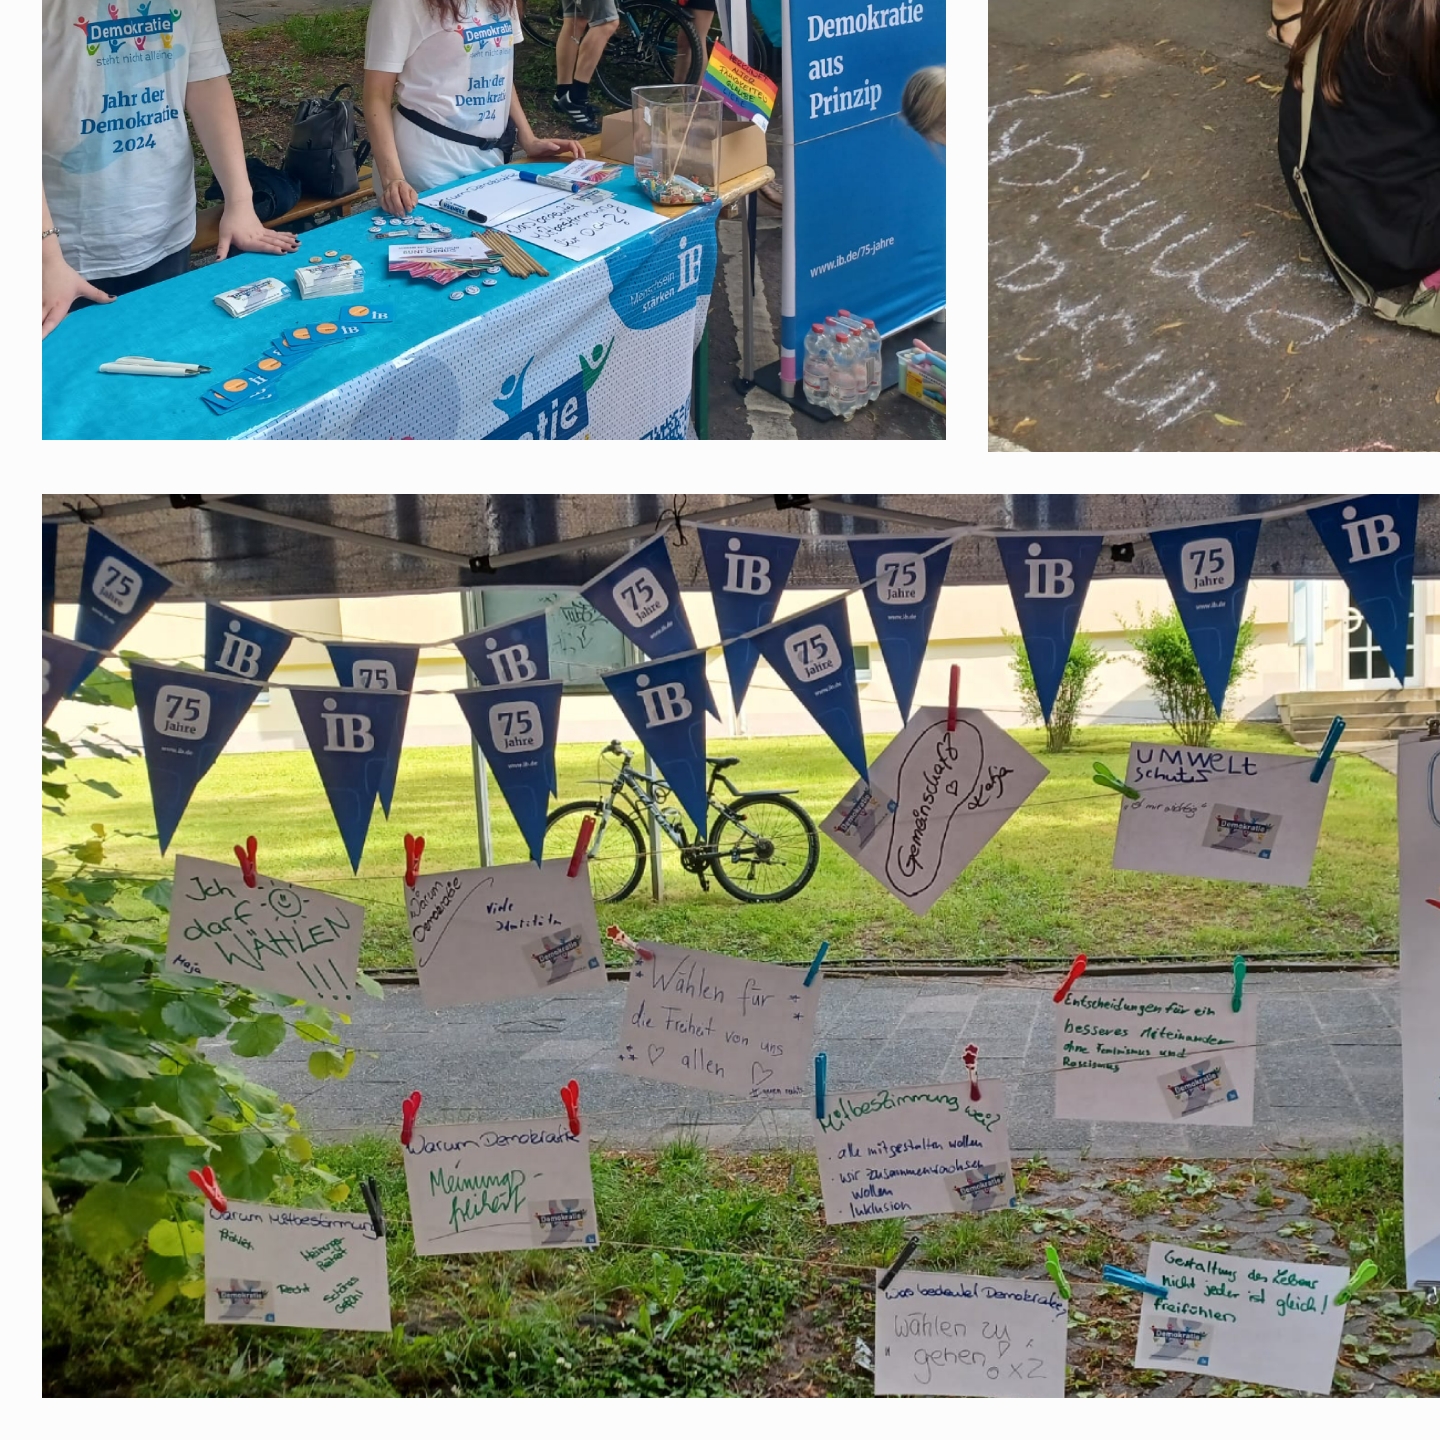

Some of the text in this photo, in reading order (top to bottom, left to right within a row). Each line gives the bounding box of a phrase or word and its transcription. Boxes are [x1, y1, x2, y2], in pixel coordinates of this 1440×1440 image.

[90, 18, 172, 42] Demokratie
[465, 23, 513, 43] Demokratie
[96, 50, 174, 68] steht nicht alleine
[807, 55, 845, 81] aus
[100, 86, 166, 114] Jahr der
[808, 79, 883, 121] Prinzip
[80, 104, 180, 136] Demokratie
[112, 133, 157, 155] 2024
[809, 234, 896, 279] www.ib.de/75-jahre
[630, 271, 676, 308] Menschsein
[642, 287, 675, 314] stärken
[1189, 546, 1226, 575] 75
[103, 566, 132, 596] 75
[883, 560, 918, 589] 75
[1193, 573, 1226, 590] Jahre
[98, 584, 124, 608] Jahre
[621, 578, 654, 609] 75
[886, 586, 917, 601] Jahre
[635, 600, 664, 623] Jahre
[793, 634, 829, 665] 75
[804, 657, 834, 677] Jahre
[165, 693, 200, 721] 75
[164, 719, 197, 736] Jahre
[497, 710, 533, 736] 75
[503, 734, 535, 749] Jahre
[897, 731, 959, 878] Gemeinschaft
[1220, 819, 1268, 835] Demokratie
[184, 875, 237, 903] Ich
[183, 901, 253, 942] darf
[213, 906, 353, 973] WÄHLEN
[651, 953, 726, 1003] Wählen
[1063, 991, 1217, 1017] Entscheidungen für ein
[631, 999, 656, 1029] die
[725, 1030, 750, 1047] von
[681, 1047, 726, 1079] allen
[406, 1134, 480, 1156] Warum
[1154, 1328, 1202, 1341] Demokratie
